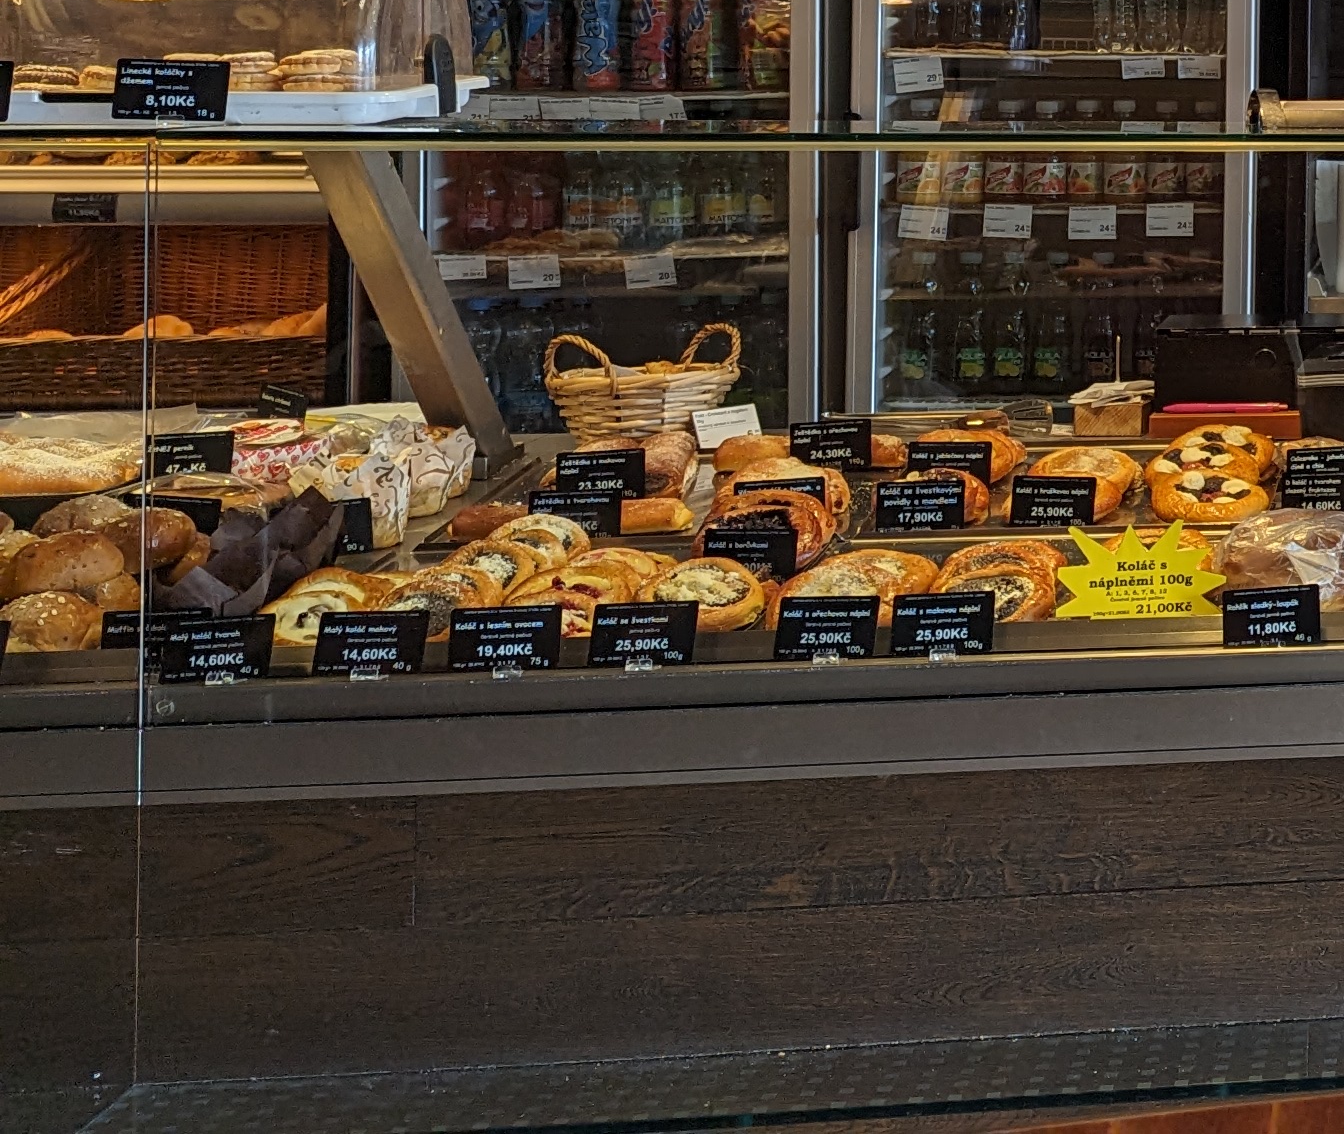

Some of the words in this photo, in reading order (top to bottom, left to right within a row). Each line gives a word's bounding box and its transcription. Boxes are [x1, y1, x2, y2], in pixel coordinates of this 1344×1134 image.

[145, 94, 195, 108] 8,10Kč
[898, 511, 943, 524] 17,90Kč
[1117, 560, 1155, 571] Koláč
[1089, 575, 1153, 590] náplněmi
[1160, 575, 1193, 586] 100g
[1136, 602, 1192, 615] 21,00Kč
[1248, 622, 1296, 636] 11,80Kč
[800, 631, 852, 645] 25,90Kč
[477, 645, 533, 658] 19,40Kč
[615, 638, 670, 652] 25,90Kč
[342, 648, 398, 661] 14,60Kč
